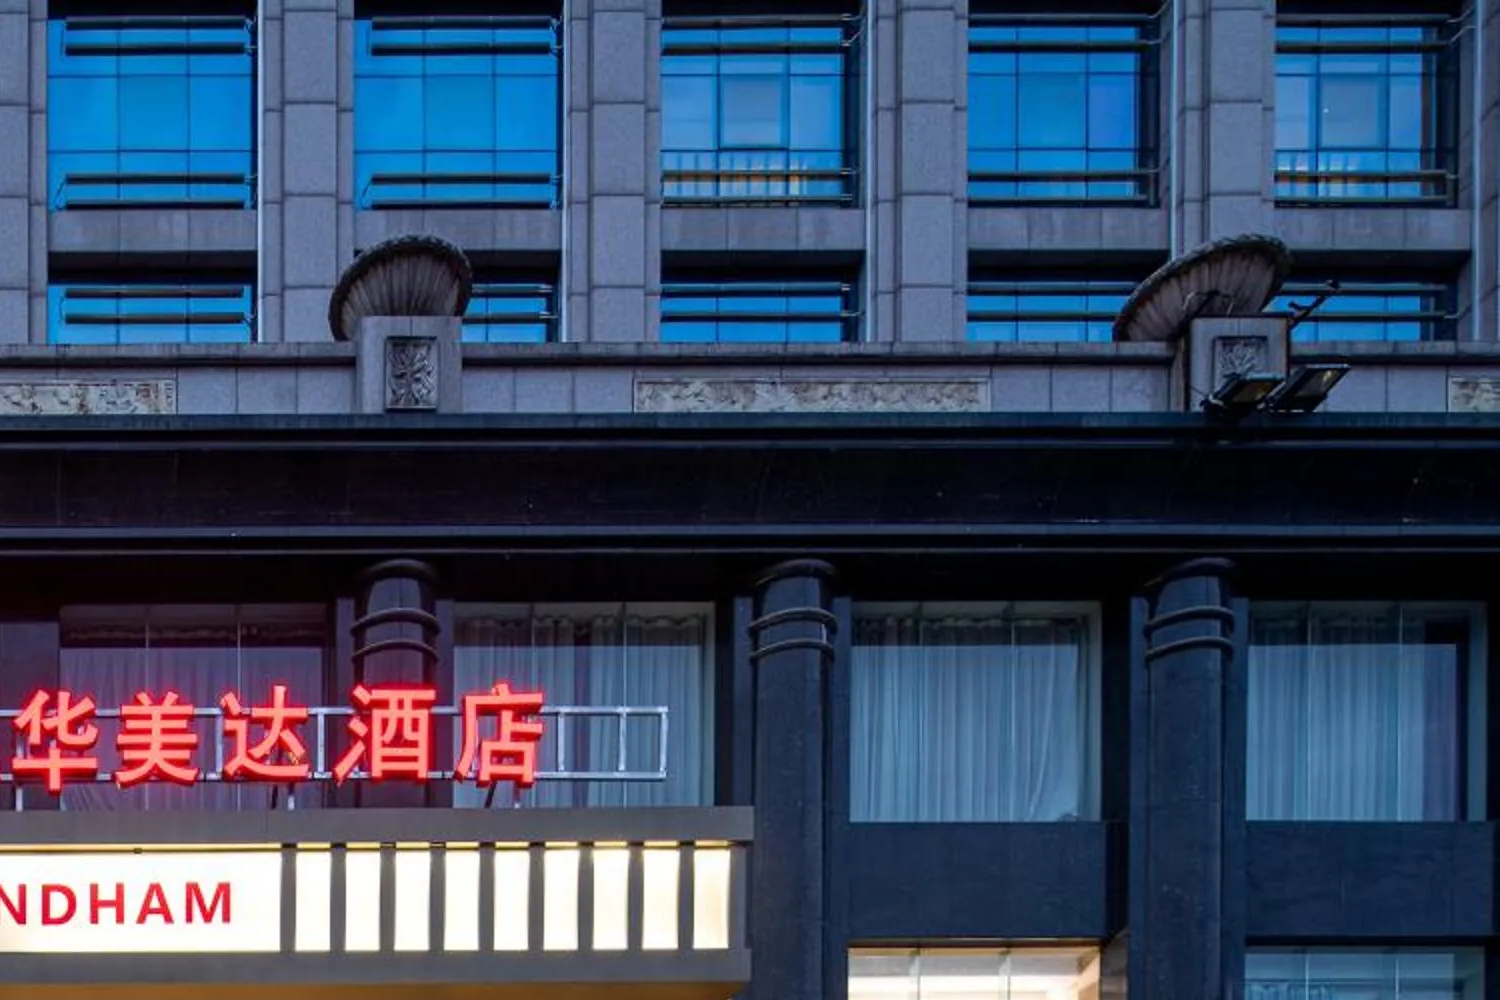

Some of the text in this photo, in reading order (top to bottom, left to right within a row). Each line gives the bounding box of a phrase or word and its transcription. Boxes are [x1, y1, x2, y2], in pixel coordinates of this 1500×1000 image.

[10, 682, 547, 793] 华美达酒店
